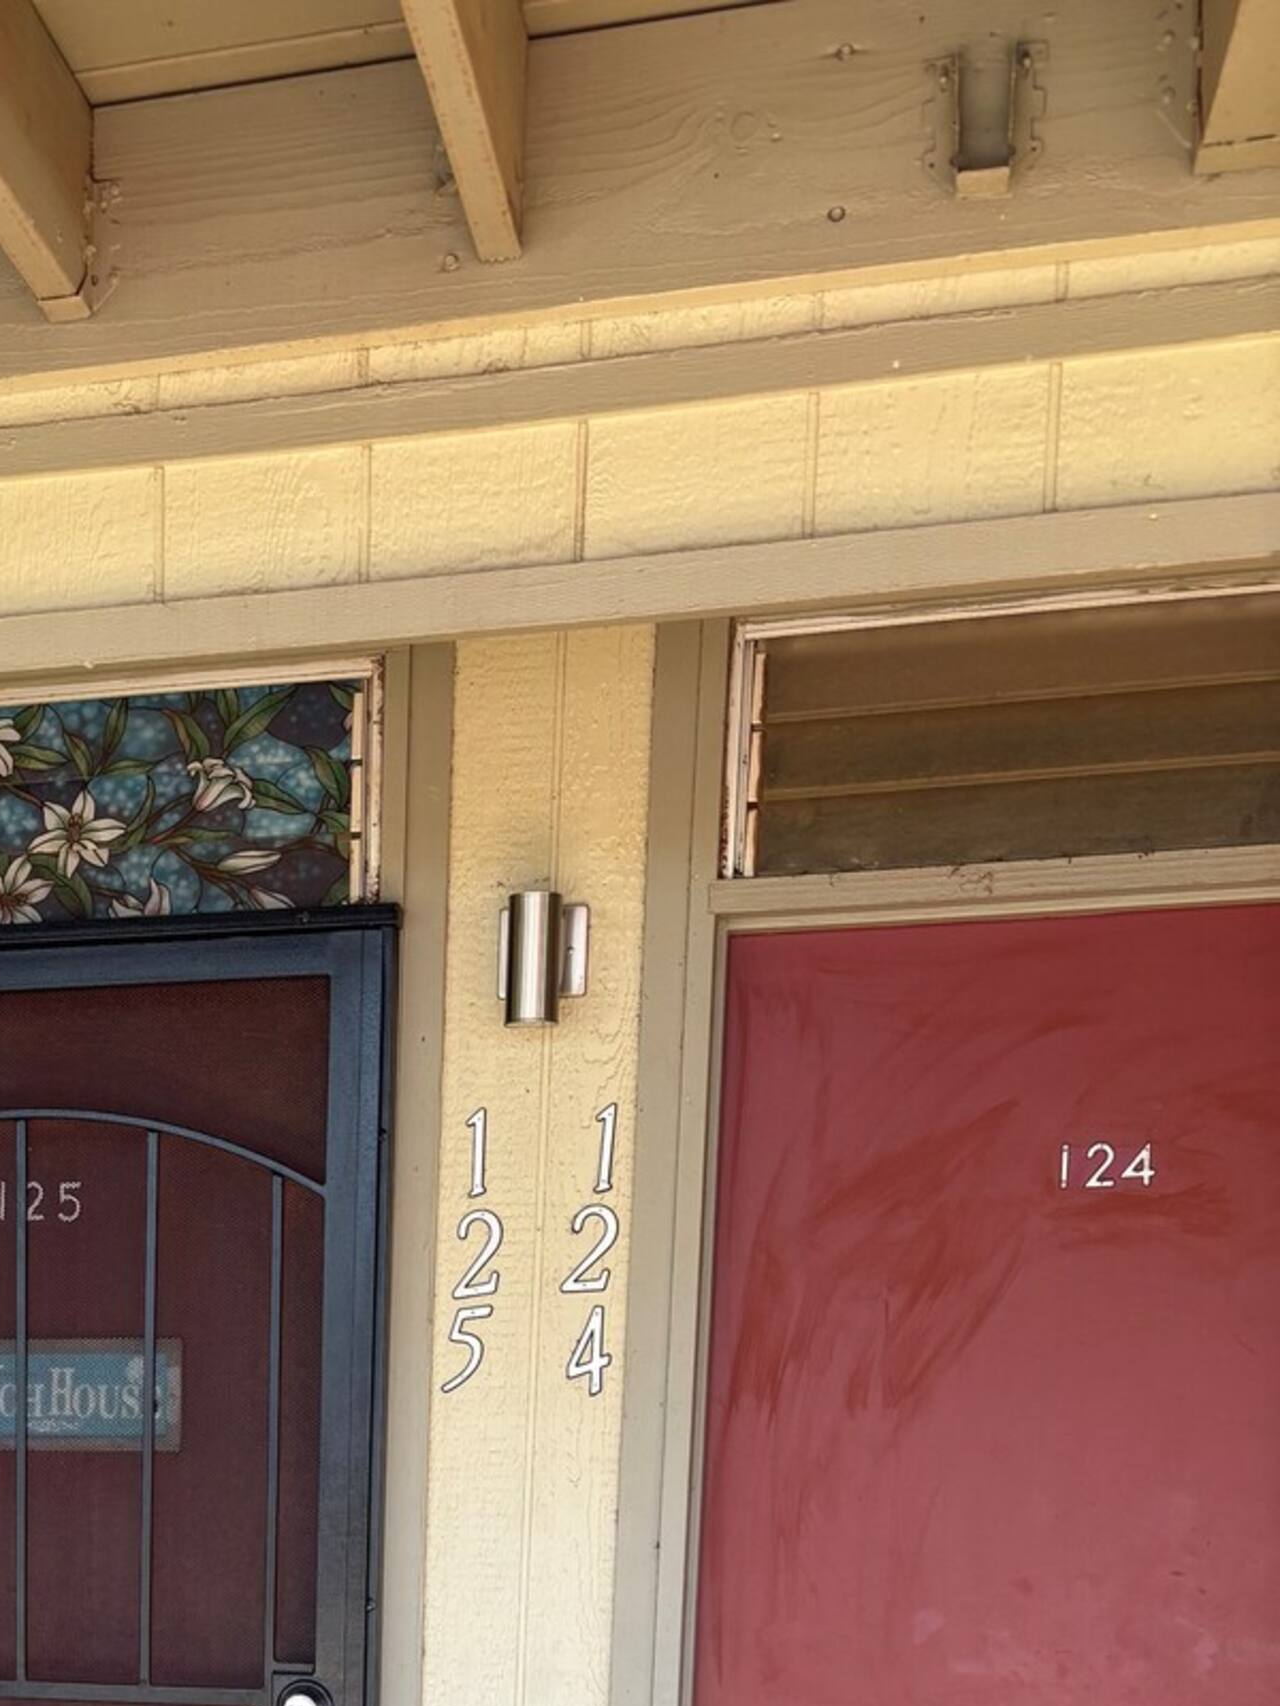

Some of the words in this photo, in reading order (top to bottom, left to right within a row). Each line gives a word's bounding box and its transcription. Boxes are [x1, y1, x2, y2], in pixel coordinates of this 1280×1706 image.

[0, 1181, 81, 1222] 125
[1060, 1142, 1155, 1188] 124
[441, 1106, 504, 1393] 125
[560, 1102, 620, 1397] 124
